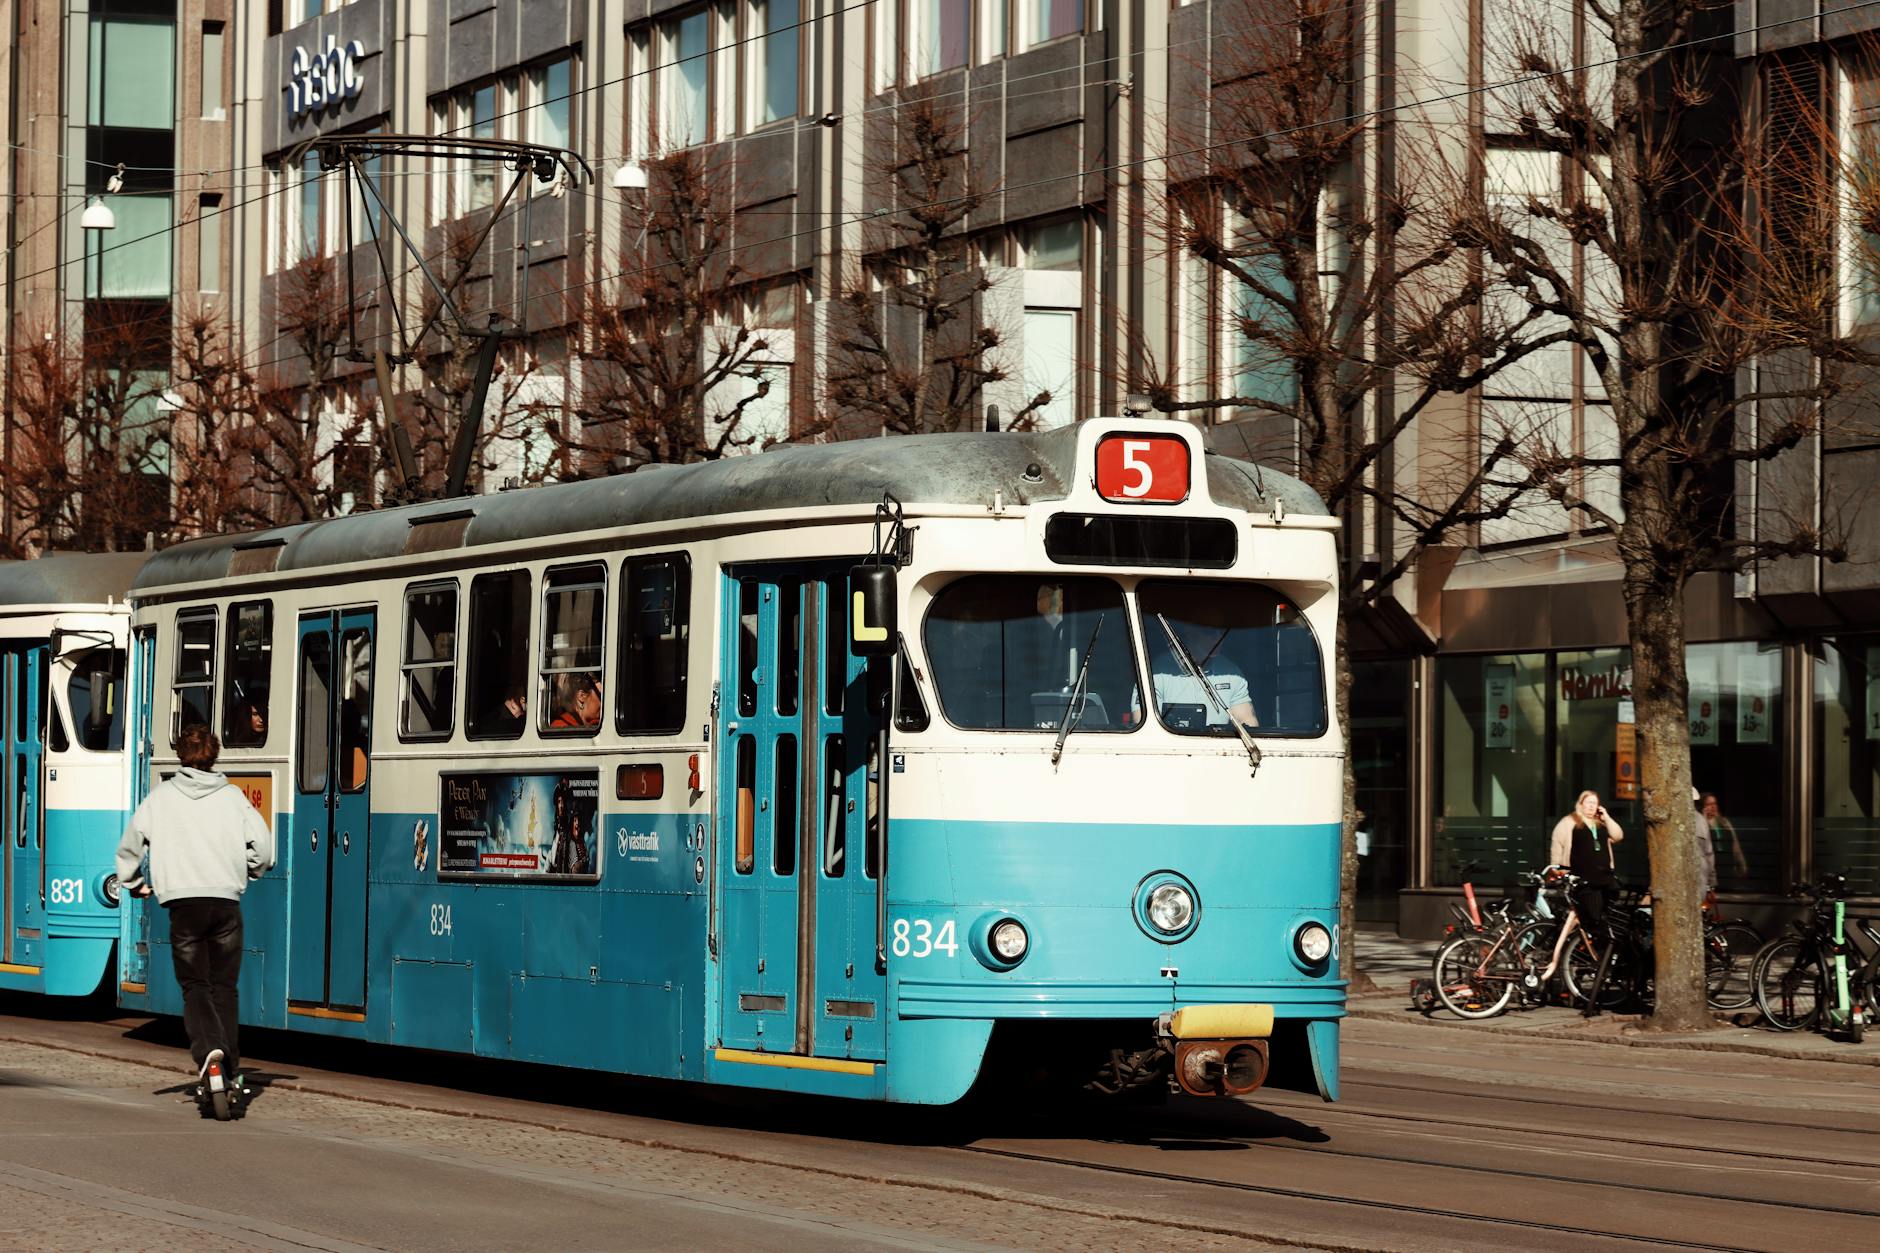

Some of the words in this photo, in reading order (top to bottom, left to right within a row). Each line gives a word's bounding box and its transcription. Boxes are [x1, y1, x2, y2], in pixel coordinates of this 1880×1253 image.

[1122, 441, 1153, 498] 5
[1561, 665, 1633, 701] Hemk
[641, 772, 647, 795] 5
[628, 831, 659, 850] västtrafik
[51, 879, 83, 904] 831
[430, 903, 452, 936] 834
[892, 918, 959, 959] 834
